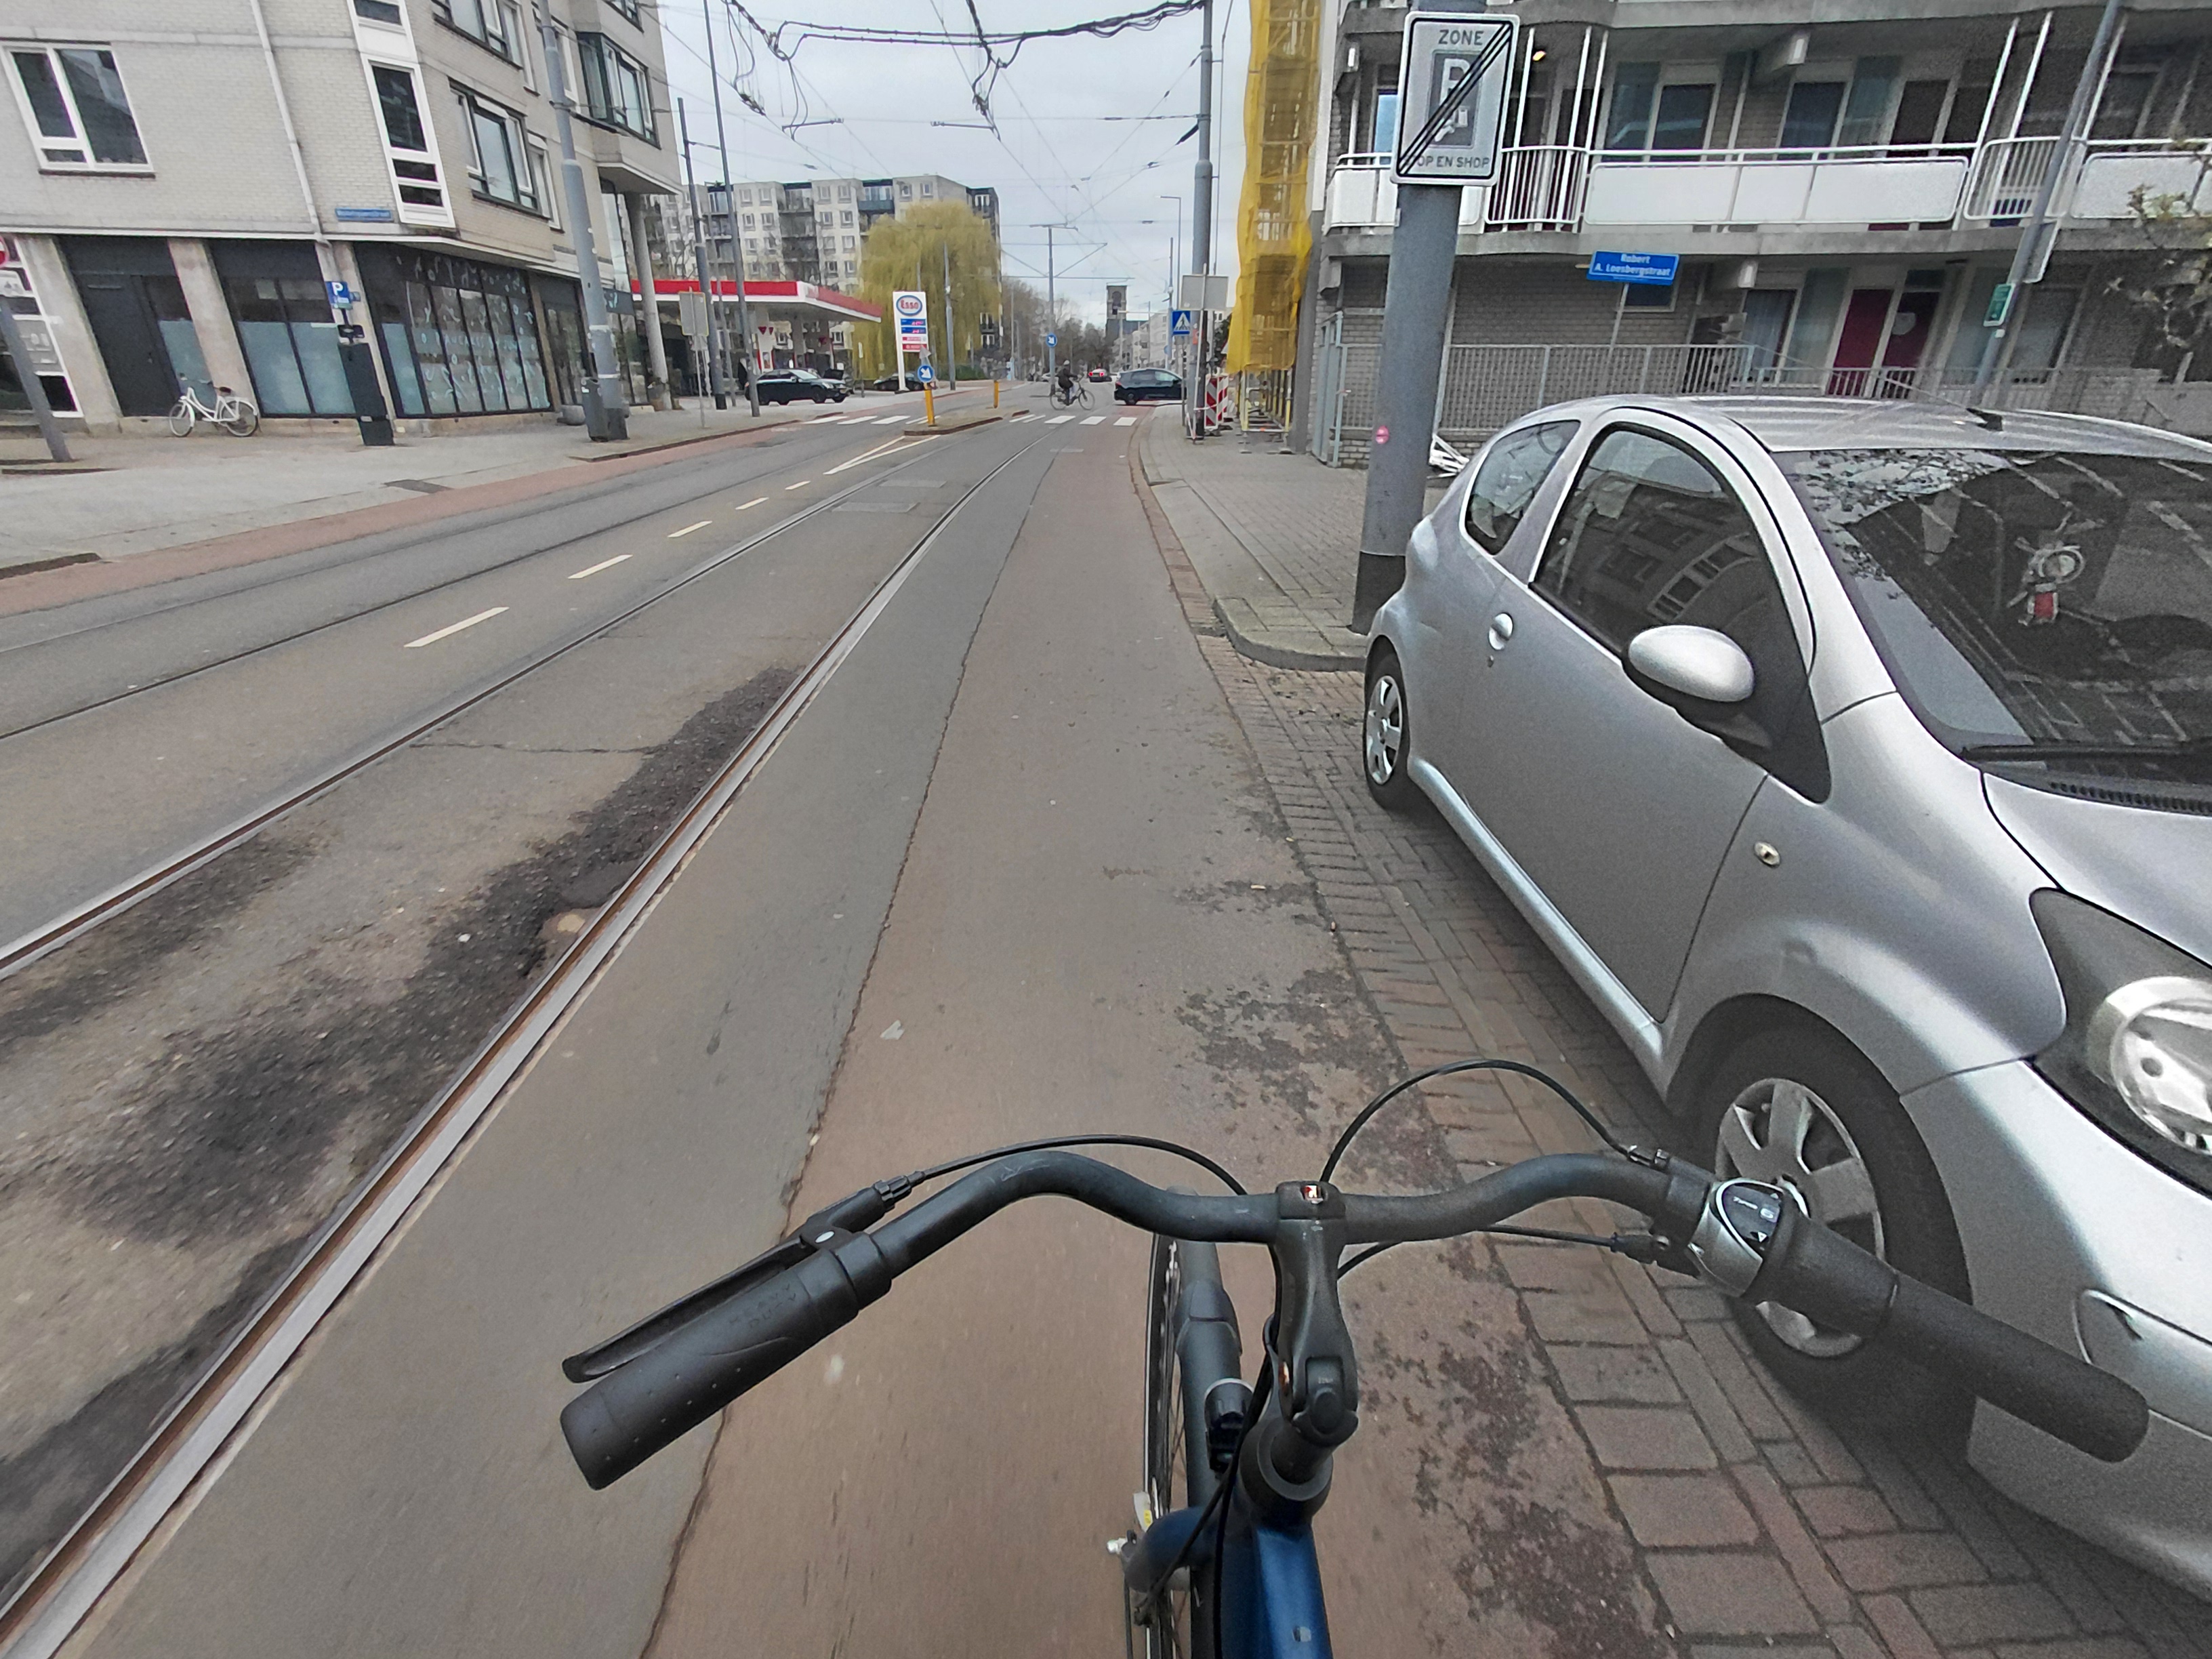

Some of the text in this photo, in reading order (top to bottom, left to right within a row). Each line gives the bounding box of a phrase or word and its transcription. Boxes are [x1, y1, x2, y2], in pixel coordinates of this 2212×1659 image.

[1437, 28, 1485, 45] ZONE
[1436, 156, 1454, 168] EN
[1456, 157, 1490, 169] SHOP
[331, 282, 344, 295] P
[900, 300, 919, 310] Esso
